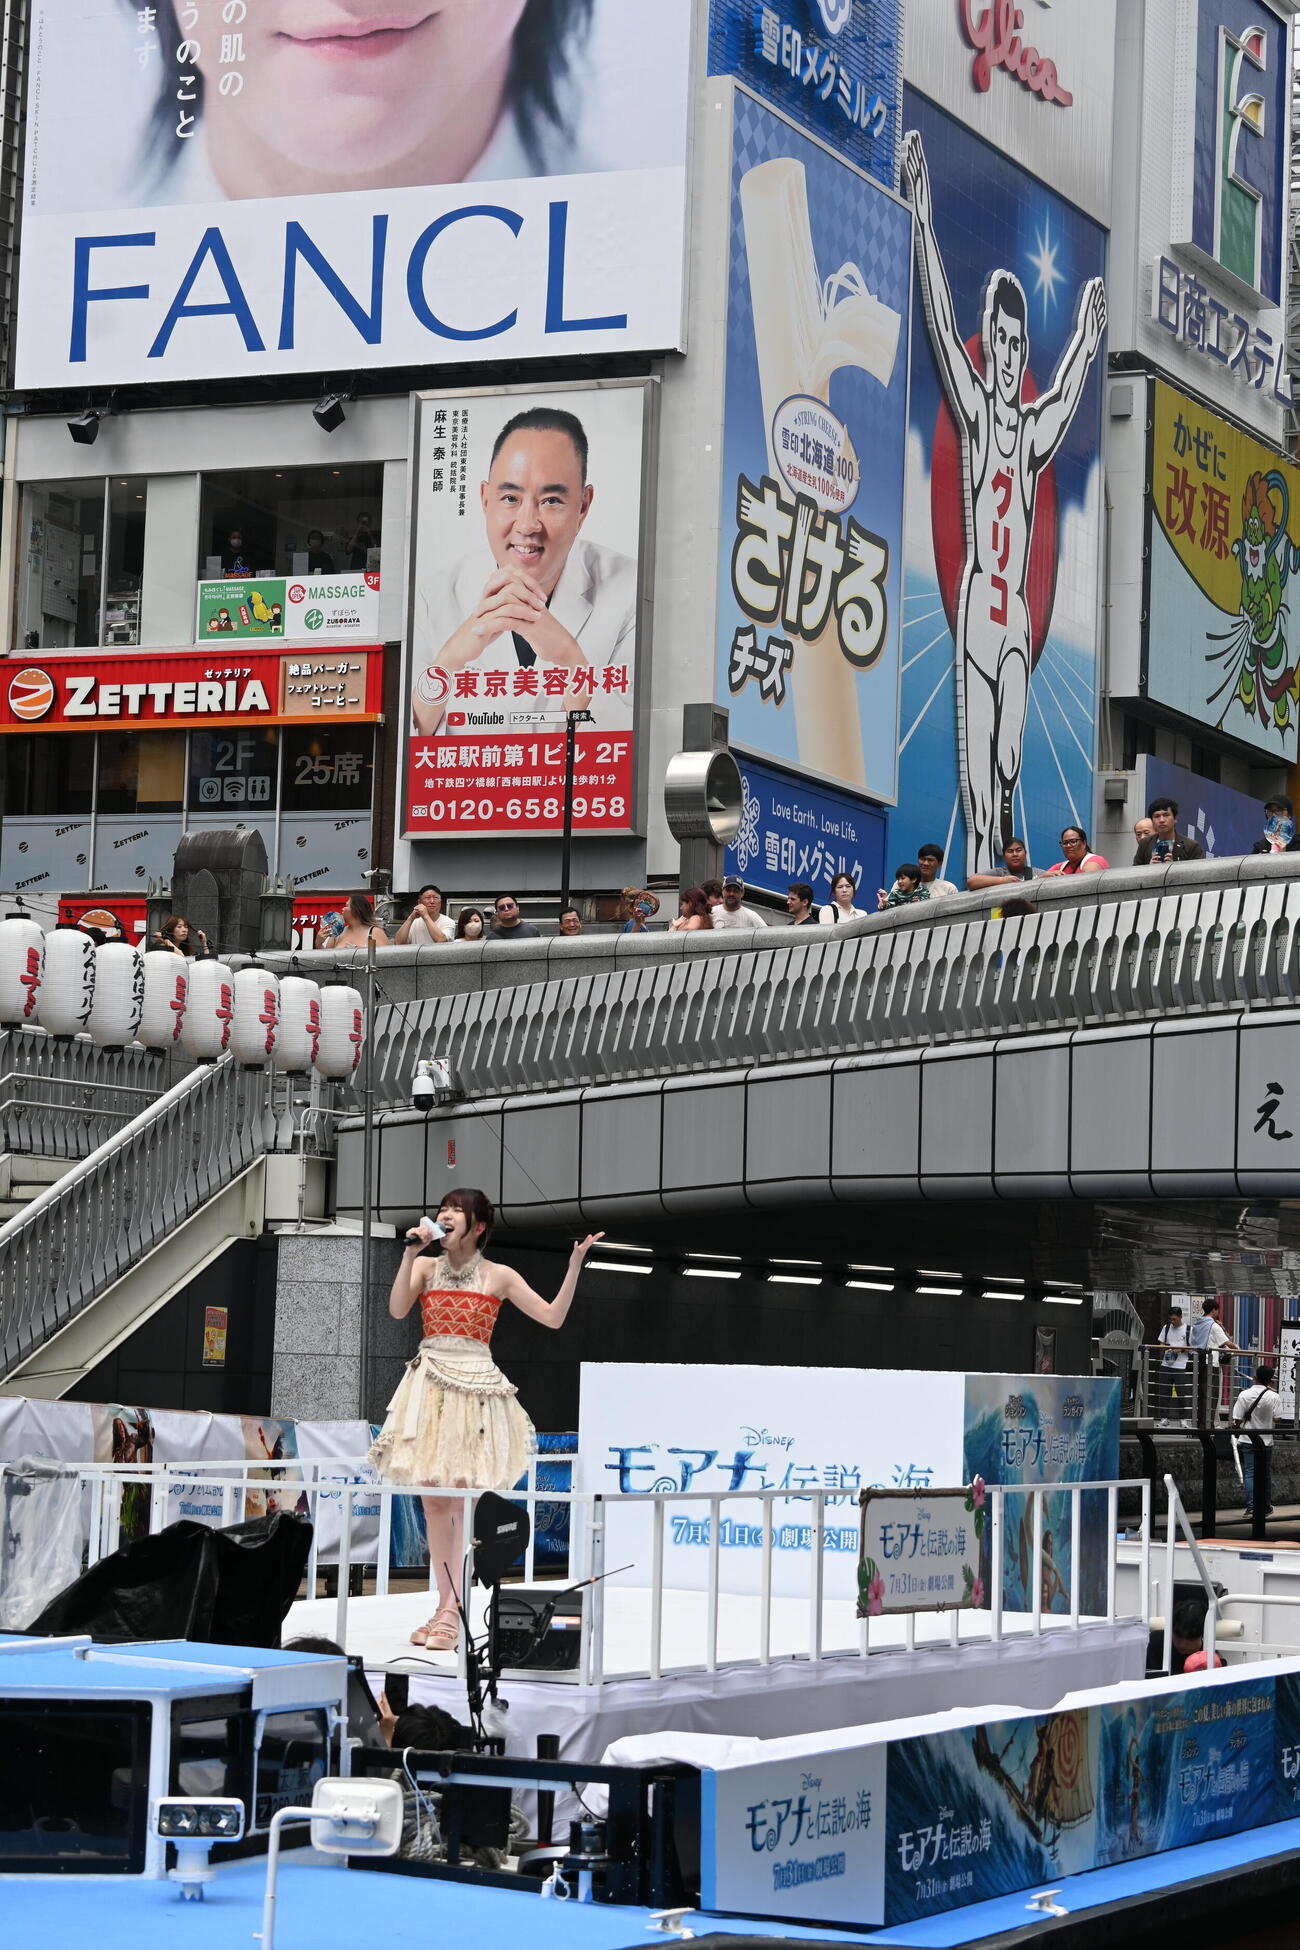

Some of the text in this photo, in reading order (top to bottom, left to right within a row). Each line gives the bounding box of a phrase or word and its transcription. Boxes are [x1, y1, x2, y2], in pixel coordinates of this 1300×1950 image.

[133, 6, 157, 71] ます
[218, 0, 246, 97] の肌の
[175, 1, 201, 138] うのこと
[761, 6, 888, 139] 雪印メグミルク
[68, 200, 628, 364] FANCL
[1158, 256, 1298, 409] 日商エステム
[432, 408, 448, 493] 麻生 泰 医師
[450, 410, 459, 458] 東京美容外科
[1173, 412, 1227, 482] かぜに
[1165, 461, 1231, 561] 改源
[989, 465, 1015, 628] グリコ
[367, 575, 380, 585] 3F
[733, 480, 887, 662] さける
[308, 585, 366, 600] MASSAGE
[204, 668, 253, 679] ゼッテリア
[288, 662, 361, 677] 絶品バーガー
[453, 664, 630, 700] 東京美容外科
[730, 628, 792, 702] チーズ
[63, 676, 271, 717] ZETTERIA
[287, 683, 345, 695] フェアトレード
[311, 695, 360, 708] コーヒー
[467, 712, 505, 726] YouTube
[571, 711, 588, 721] 検索
[215, 740, 256, 771] 2F
[295, 752, 363, 785] 25席
[595, 742, 628, 765] 2F
[113, 830, 149, 849] ZETTERIA
[772, 797, 858, 843] Love Earth. Love Life.
[15, 871, 51, 890] ZETTERIA
[294, 866, 330, 886] ZETTERIA
[1254, 1081, 1294, 1141] え
[740, 1425, 796, 1452] Disney
[1001, 1427, 1087, 1468] モアナと伝説の海
[879, 1523, 967, 1560] モアナと伝説の海
[744, 1789, 872, 1853] モアナと伝説の海
[897, 1817, 992, 1872] モアナと伝説の海
